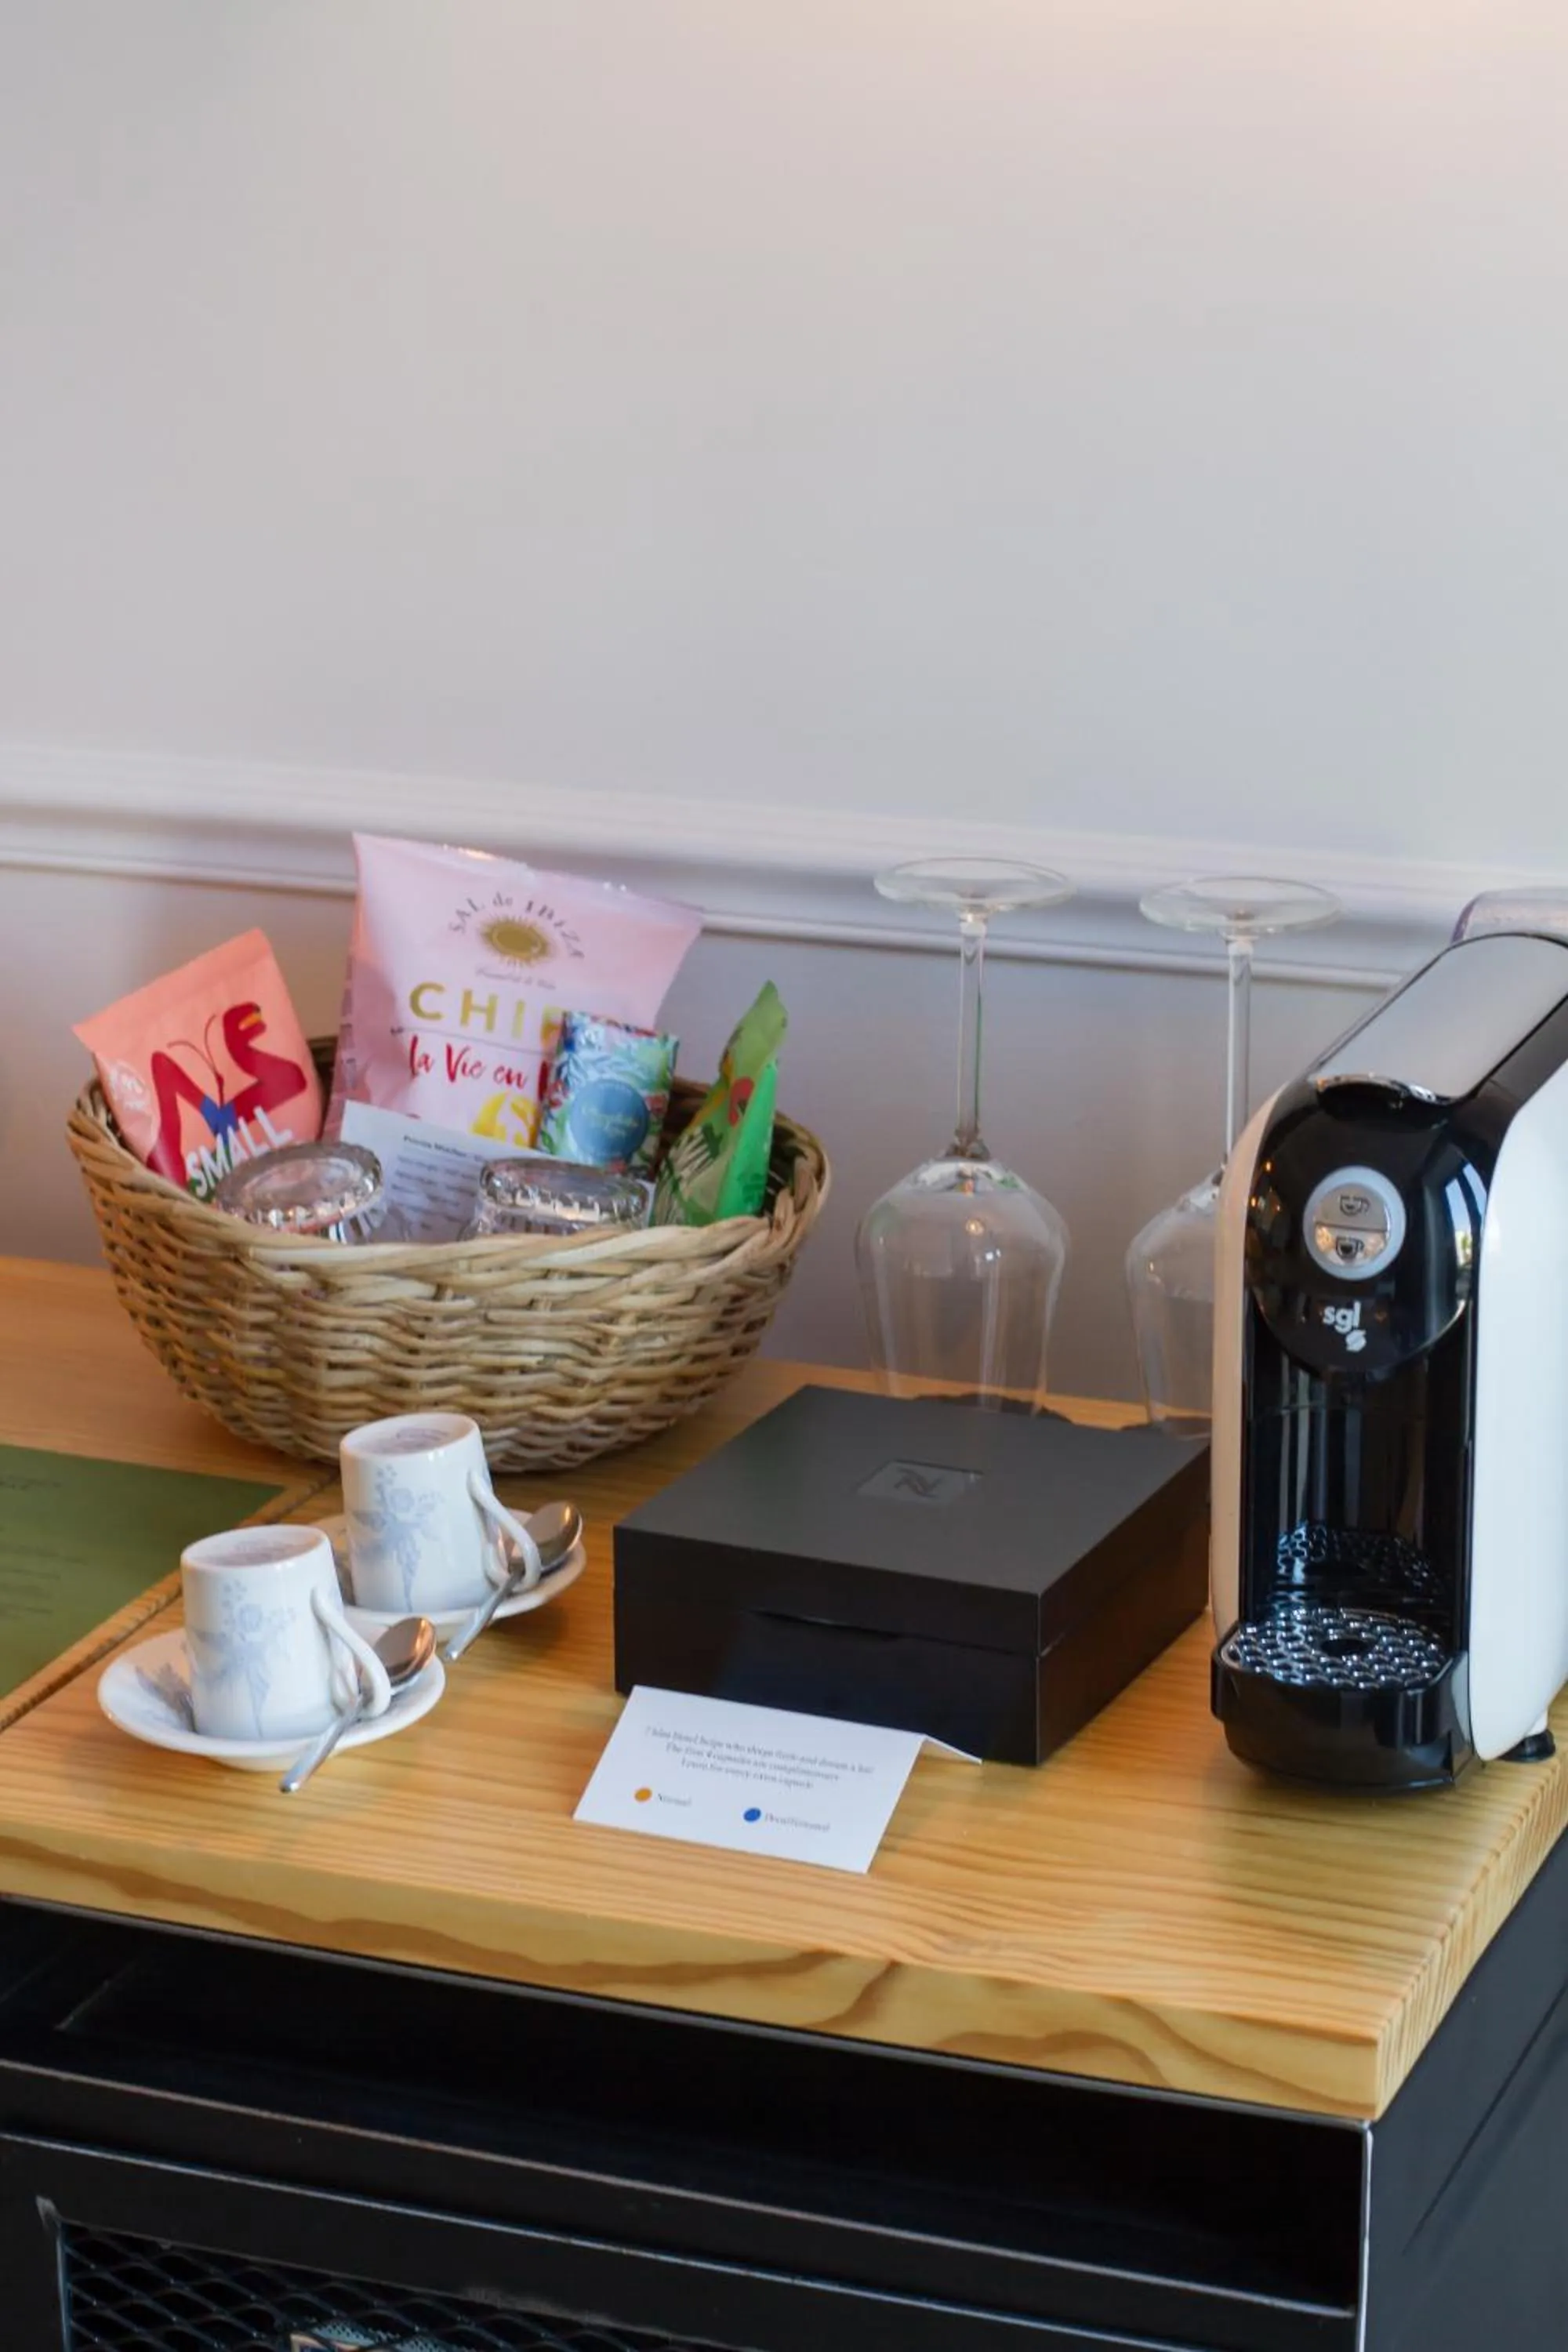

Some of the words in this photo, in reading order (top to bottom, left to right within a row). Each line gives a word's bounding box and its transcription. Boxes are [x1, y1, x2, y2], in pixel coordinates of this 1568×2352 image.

[448, 898, 485, 934] SAL
[492, 891, 513, 906] de
[409, 982, 568, 1053] CHIP
[409, 1034, 434, 1078] la
[446, 1043, 486, 1083] Vie
[493, 1065, 528, 1090] en
[186, 1105, 293, 1197] SMALL
[1323, 1301, 1361, 1334] sgl
